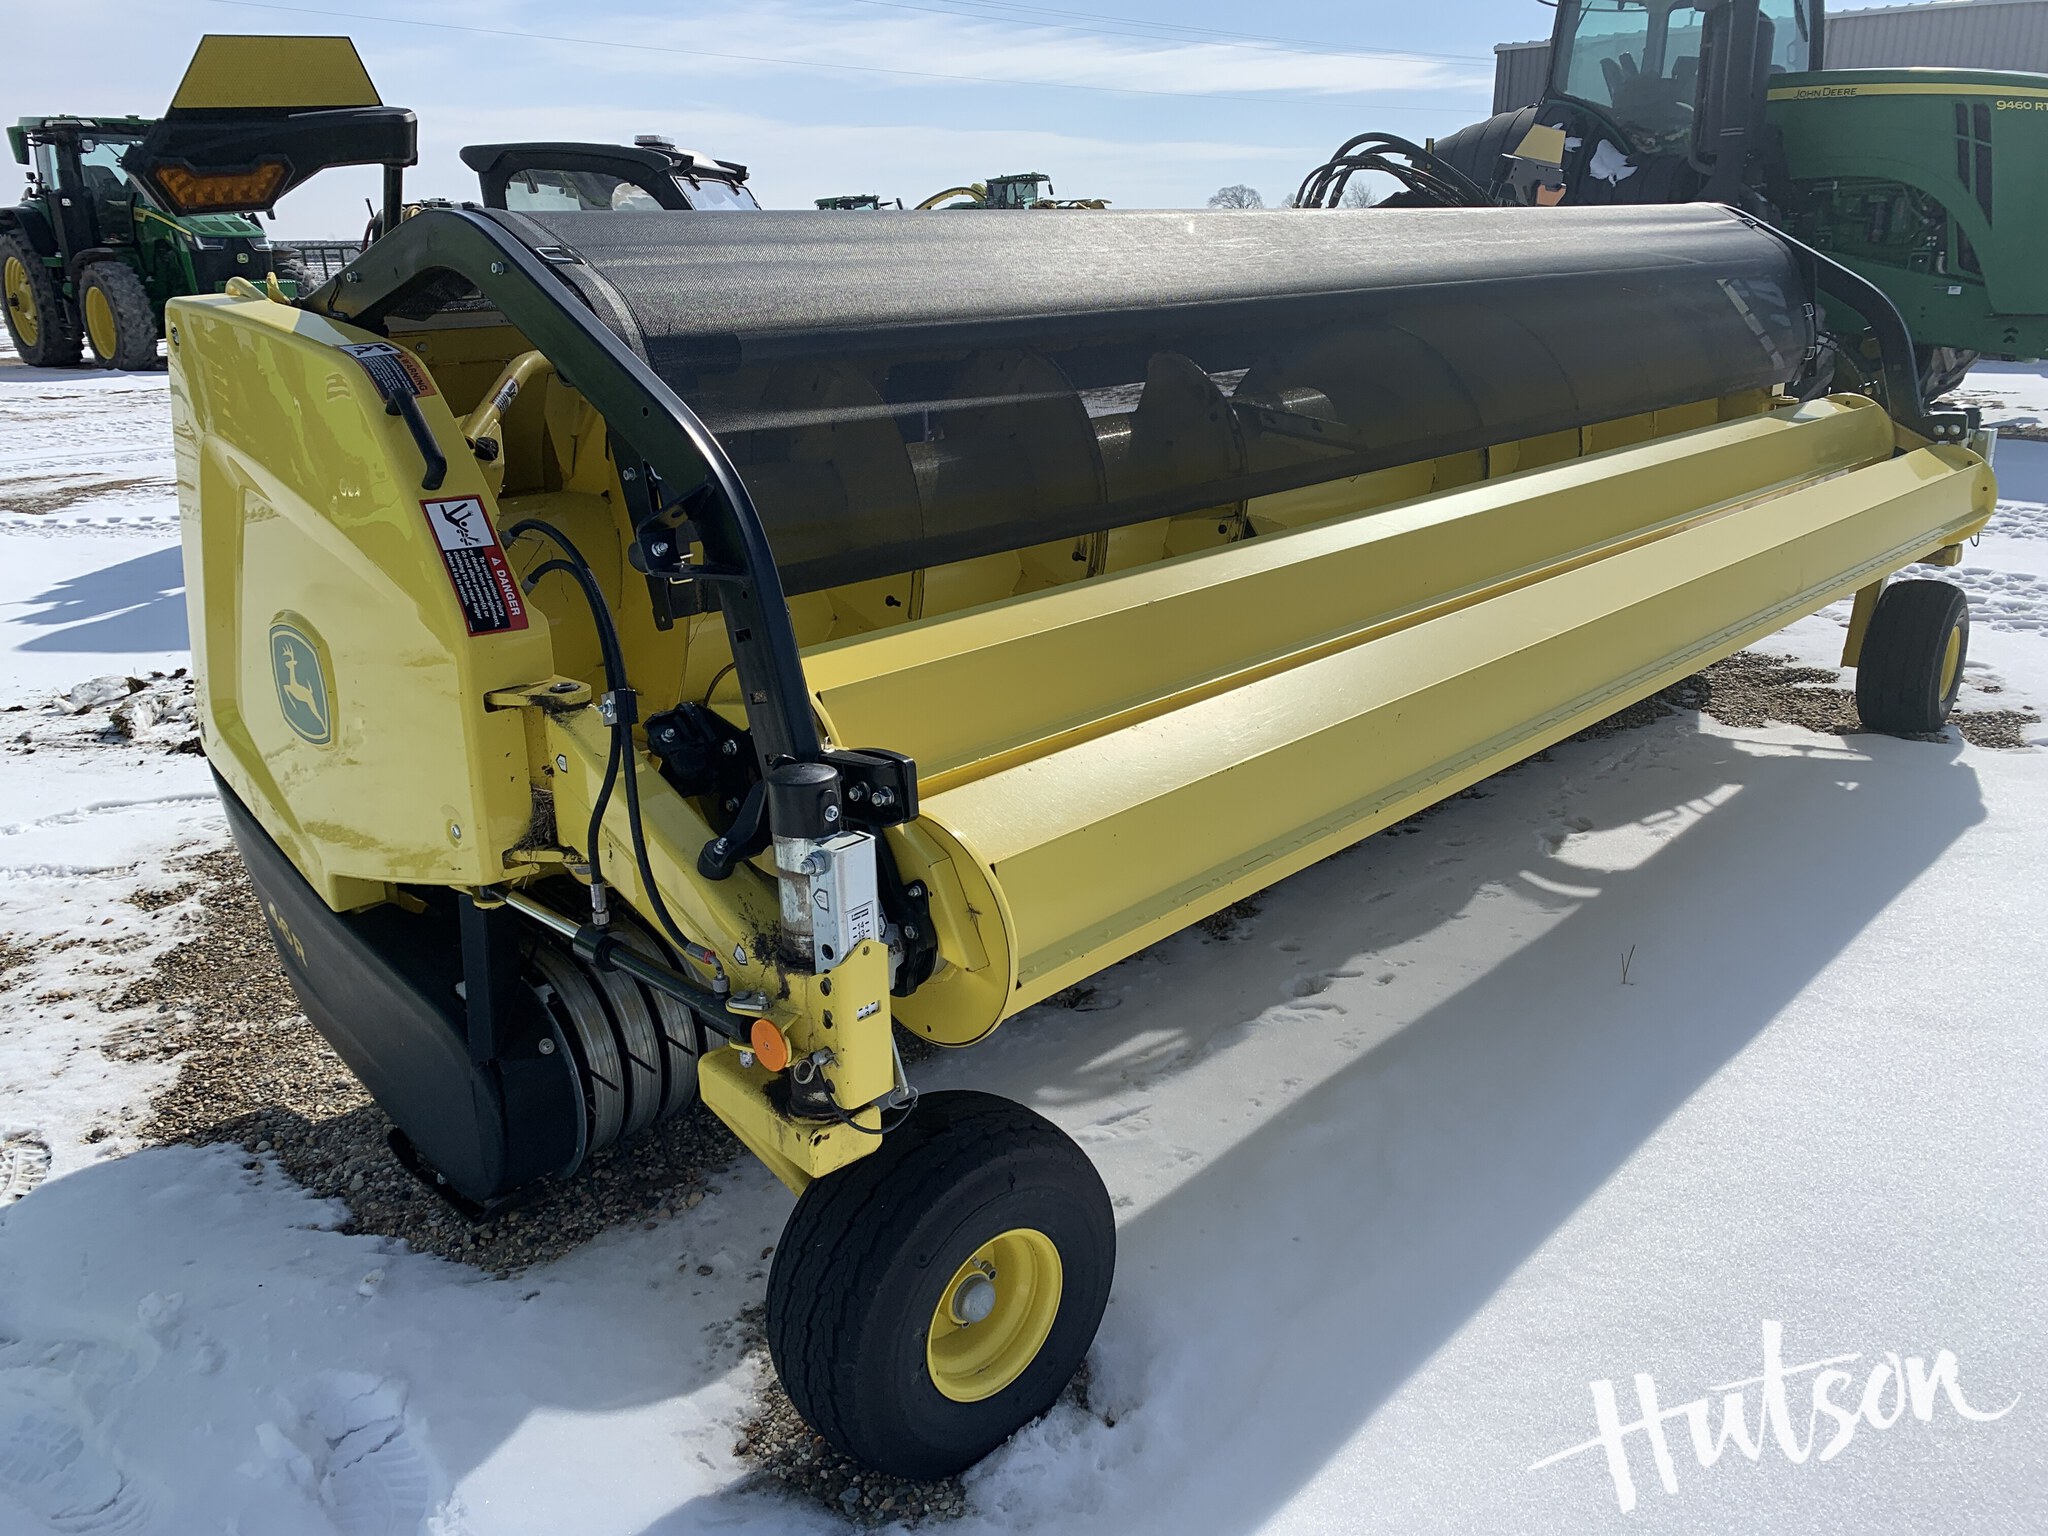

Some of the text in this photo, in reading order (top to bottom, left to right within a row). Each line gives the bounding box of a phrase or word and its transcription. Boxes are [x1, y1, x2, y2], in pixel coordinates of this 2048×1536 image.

[1793, 87, 1857, 99] JOHN DEERE
[1996, 100, 2032, 110] 9460
[402, 356, 427, 391] WARNING
[473, 584, 487, 610] person(s)
[496, 569, 520, 615] DANGER
[496, 600, 505, 616] injury
